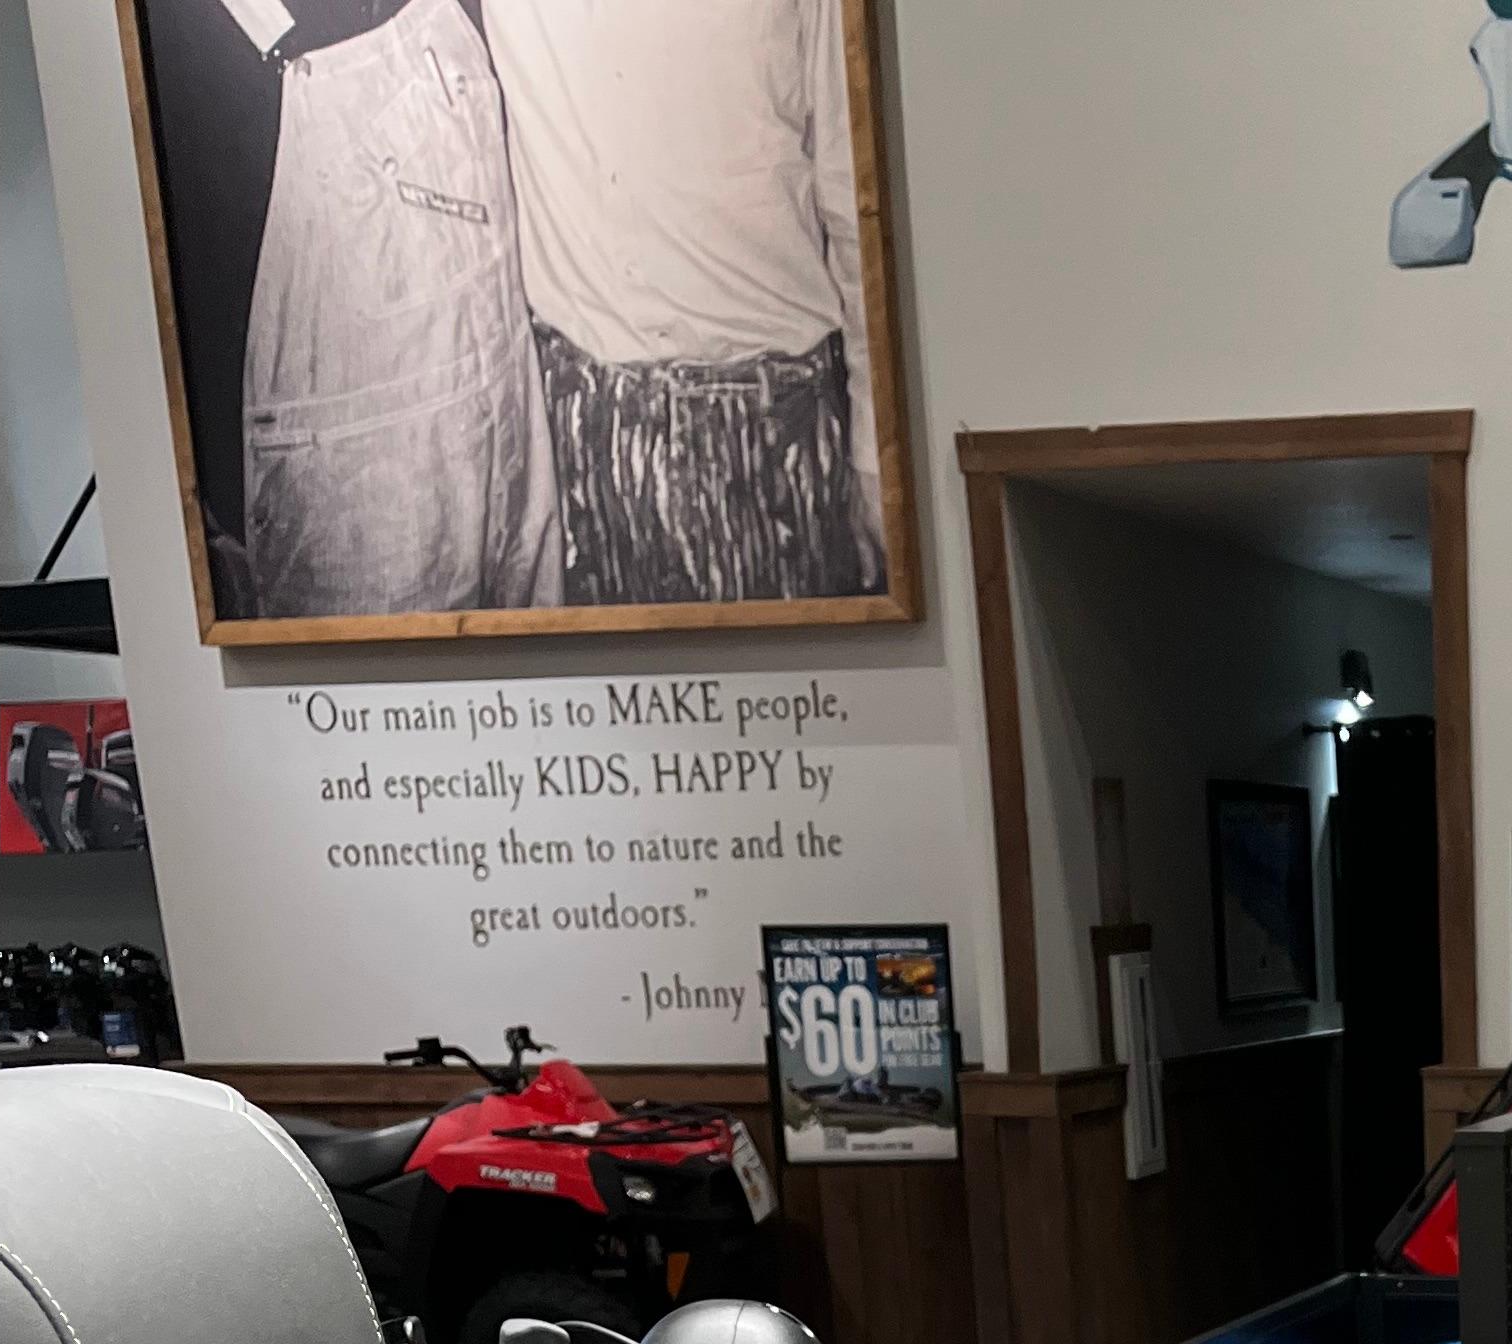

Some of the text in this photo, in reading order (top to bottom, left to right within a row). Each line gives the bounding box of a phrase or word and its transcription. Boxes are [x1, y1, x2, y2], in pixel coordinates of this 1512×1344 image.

[288, 679, 849, 741] “Our main job is to MAKE people,
[320, 762, 371, 801] and
[384, 761, 525, 813] especially
[651, 749, 783, 794] HAPPY
[797, 750, 835, 803] by
[327, 821, 844, 881] connecting them to nature and the
[470, 901, 540, 947] great
[773, 956, 867, 983] EARN UP TO
[641, 971, 746, 1022] Johnny
[878, 999, 896, 1025] IN
[778, 984, 878, 1077] $60
[880, 1026, 942, 1052] POINTS
[479, 1164, 557, 1183] TRACKER
